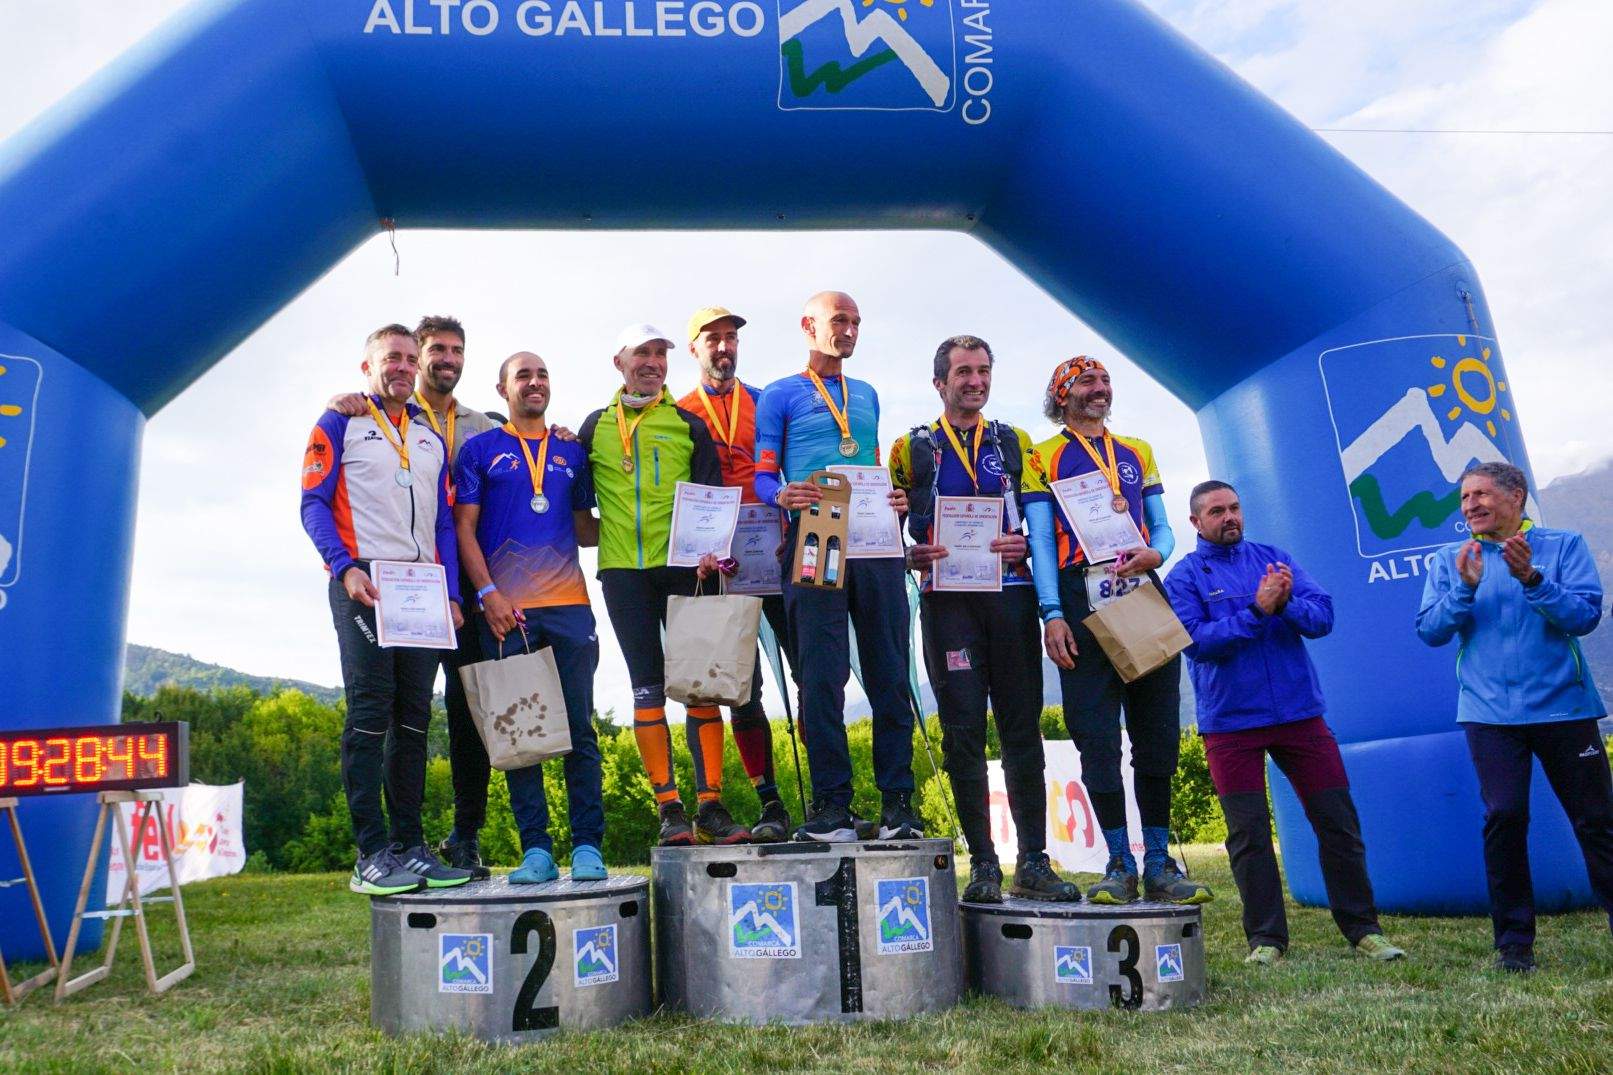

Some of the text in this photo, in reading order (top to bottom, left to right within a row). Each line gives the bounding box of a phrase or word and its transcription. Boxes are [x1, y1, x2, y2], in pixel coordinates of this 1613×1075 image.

[363, 0, 765, 37] ALTO GALLEGO
[510, 909, 560, 1032] 2
[814, 856, 864, 1013] 1
[1107, 924, 1143, 1010] 3
